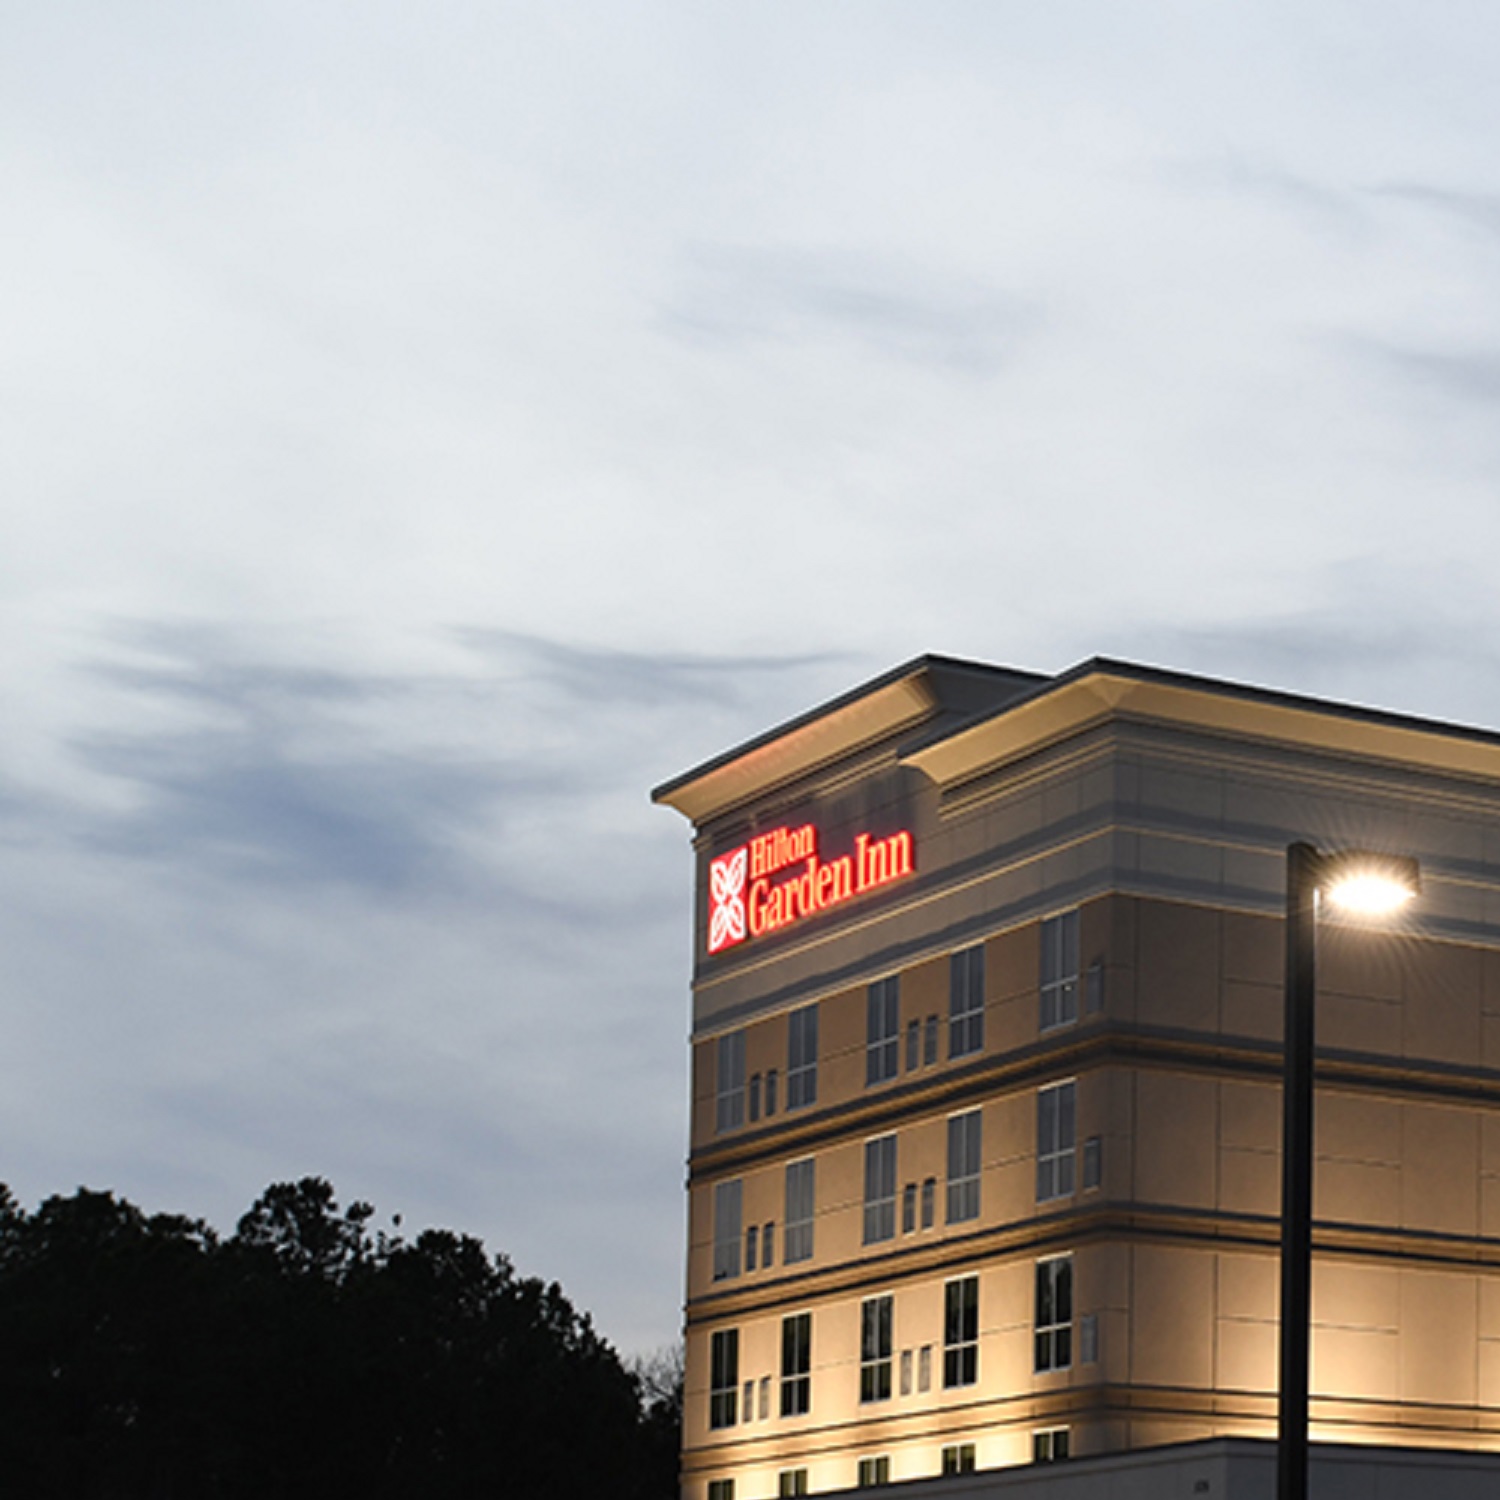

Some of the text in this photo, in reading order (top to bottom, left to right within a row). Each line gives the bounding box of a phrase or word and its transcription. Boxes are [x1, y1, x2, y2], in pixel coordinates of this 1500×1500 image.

[749, 830, 913, 936] Garden Inn
[750, 824, 816, 878] Hilton
